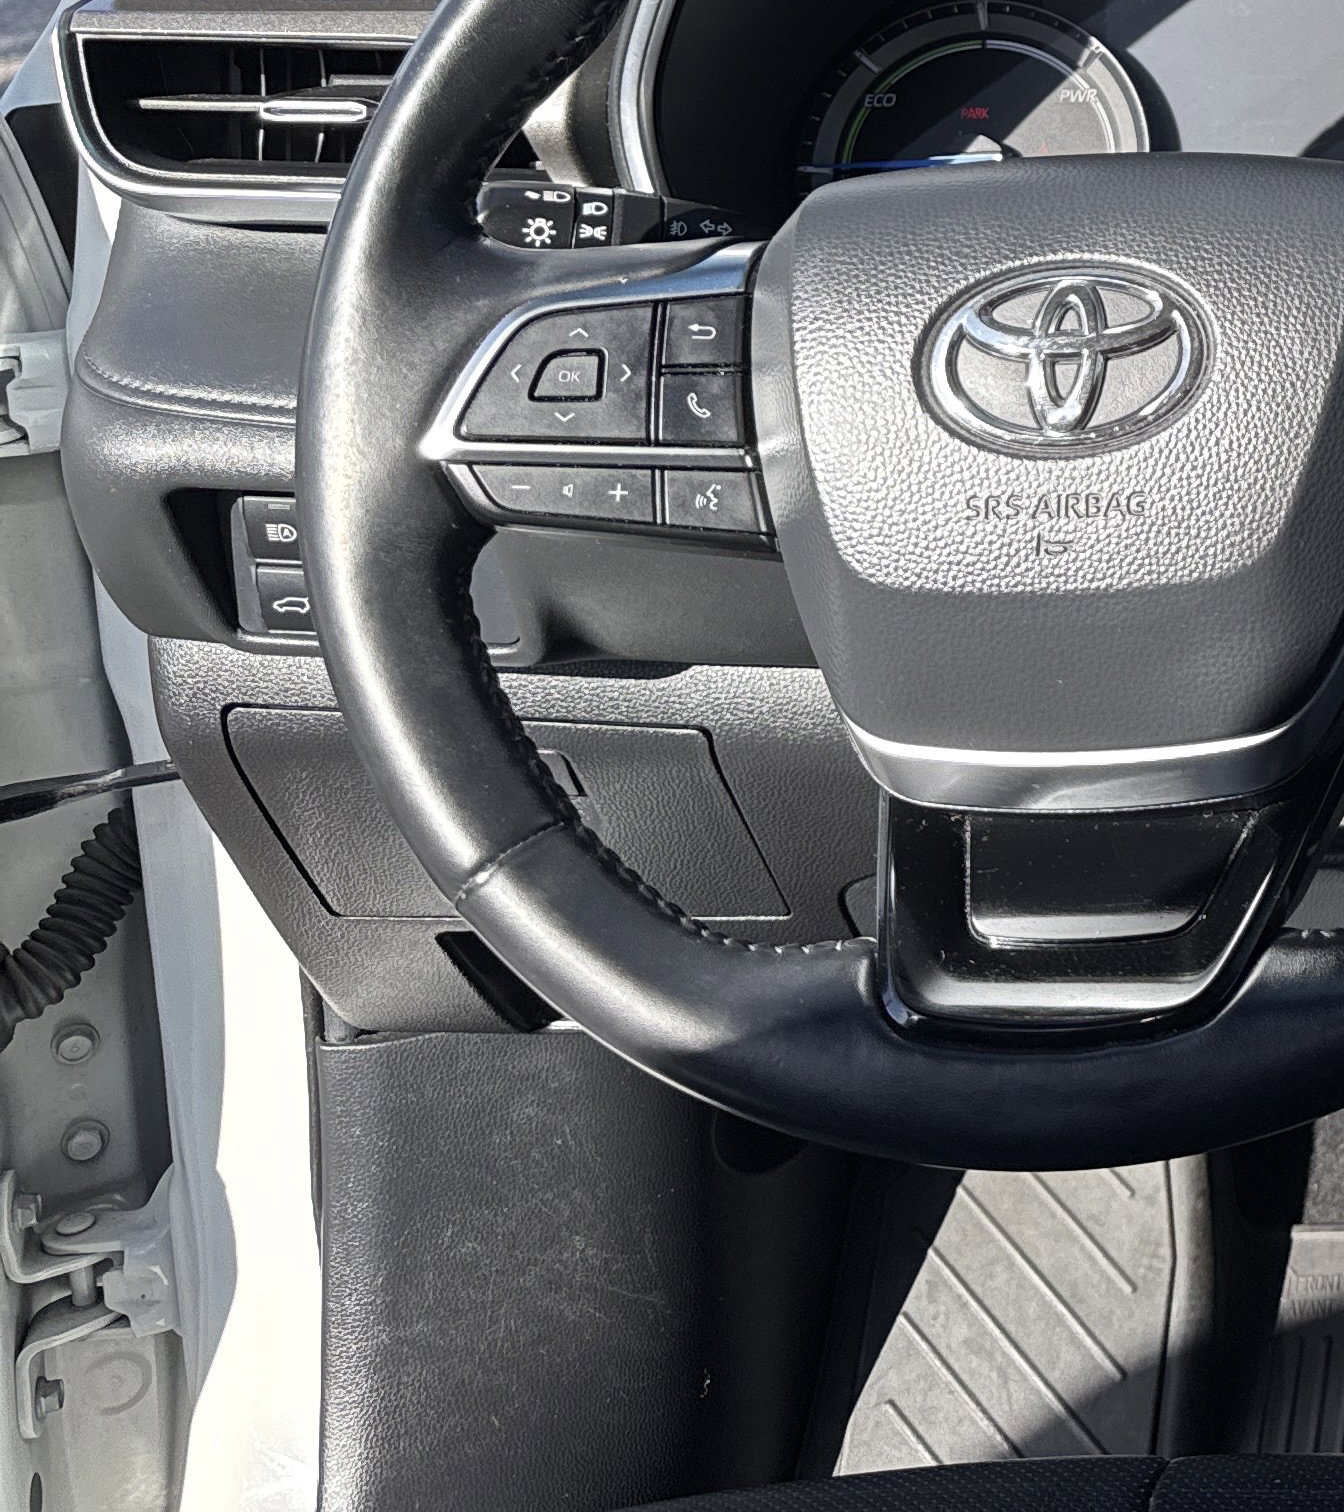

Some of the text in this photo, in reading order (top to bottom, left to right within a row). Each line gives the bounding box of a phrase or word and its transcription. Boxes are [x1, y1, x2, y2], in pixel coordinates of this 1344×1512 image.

[863, 93, 897, 108] ECO
[1058, 89, 1098, 103] PWR
[960, 107, 990, 120] PARK
[558, 370, 581, 383] OK
[966, 490, 1149, 522] SRS AIRBAG
